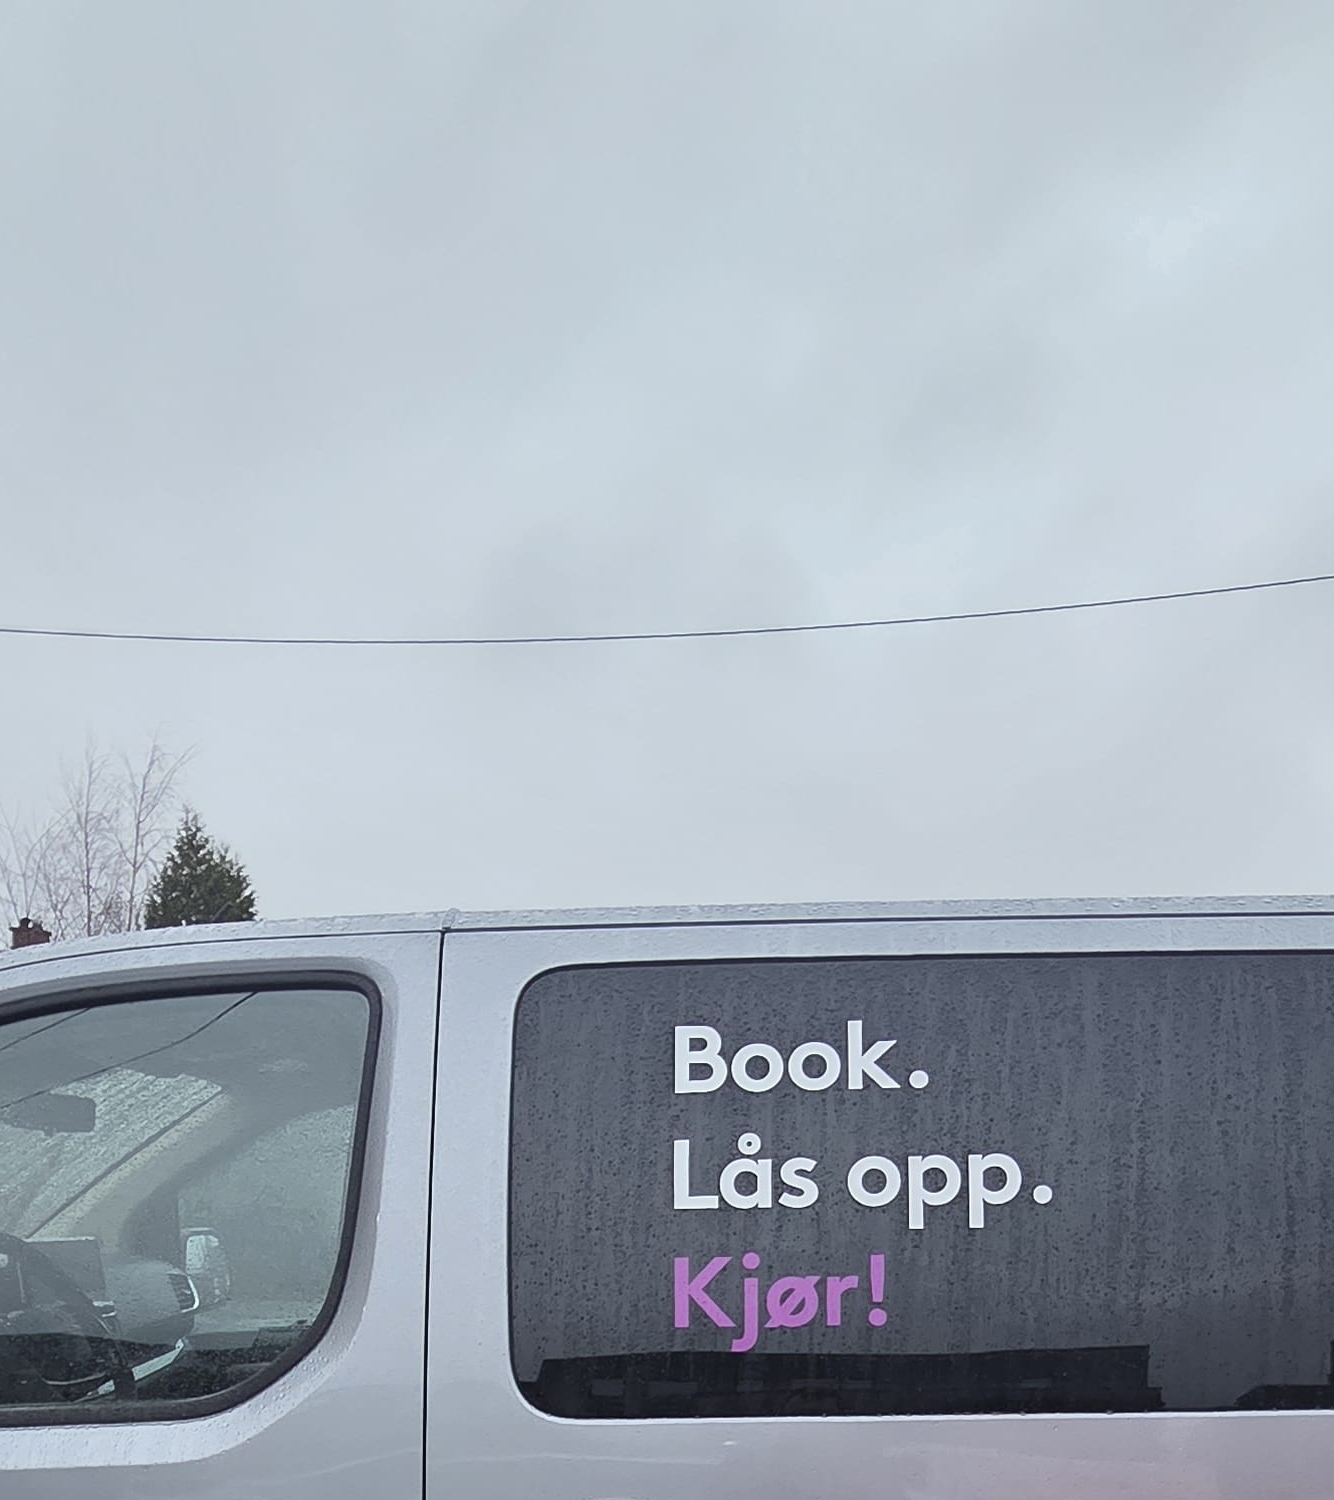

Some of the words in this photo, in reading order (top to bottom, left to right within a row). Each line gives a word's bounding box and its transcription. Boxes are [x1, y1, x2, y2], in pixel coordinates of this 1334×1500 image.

[673, 1019, 929, 1094] Book.
[673, 1132, 819, 1210] Lås
[847, 1152, 1053, 1230] opp.
[673, 1252, 889, 1353] Kjør!
